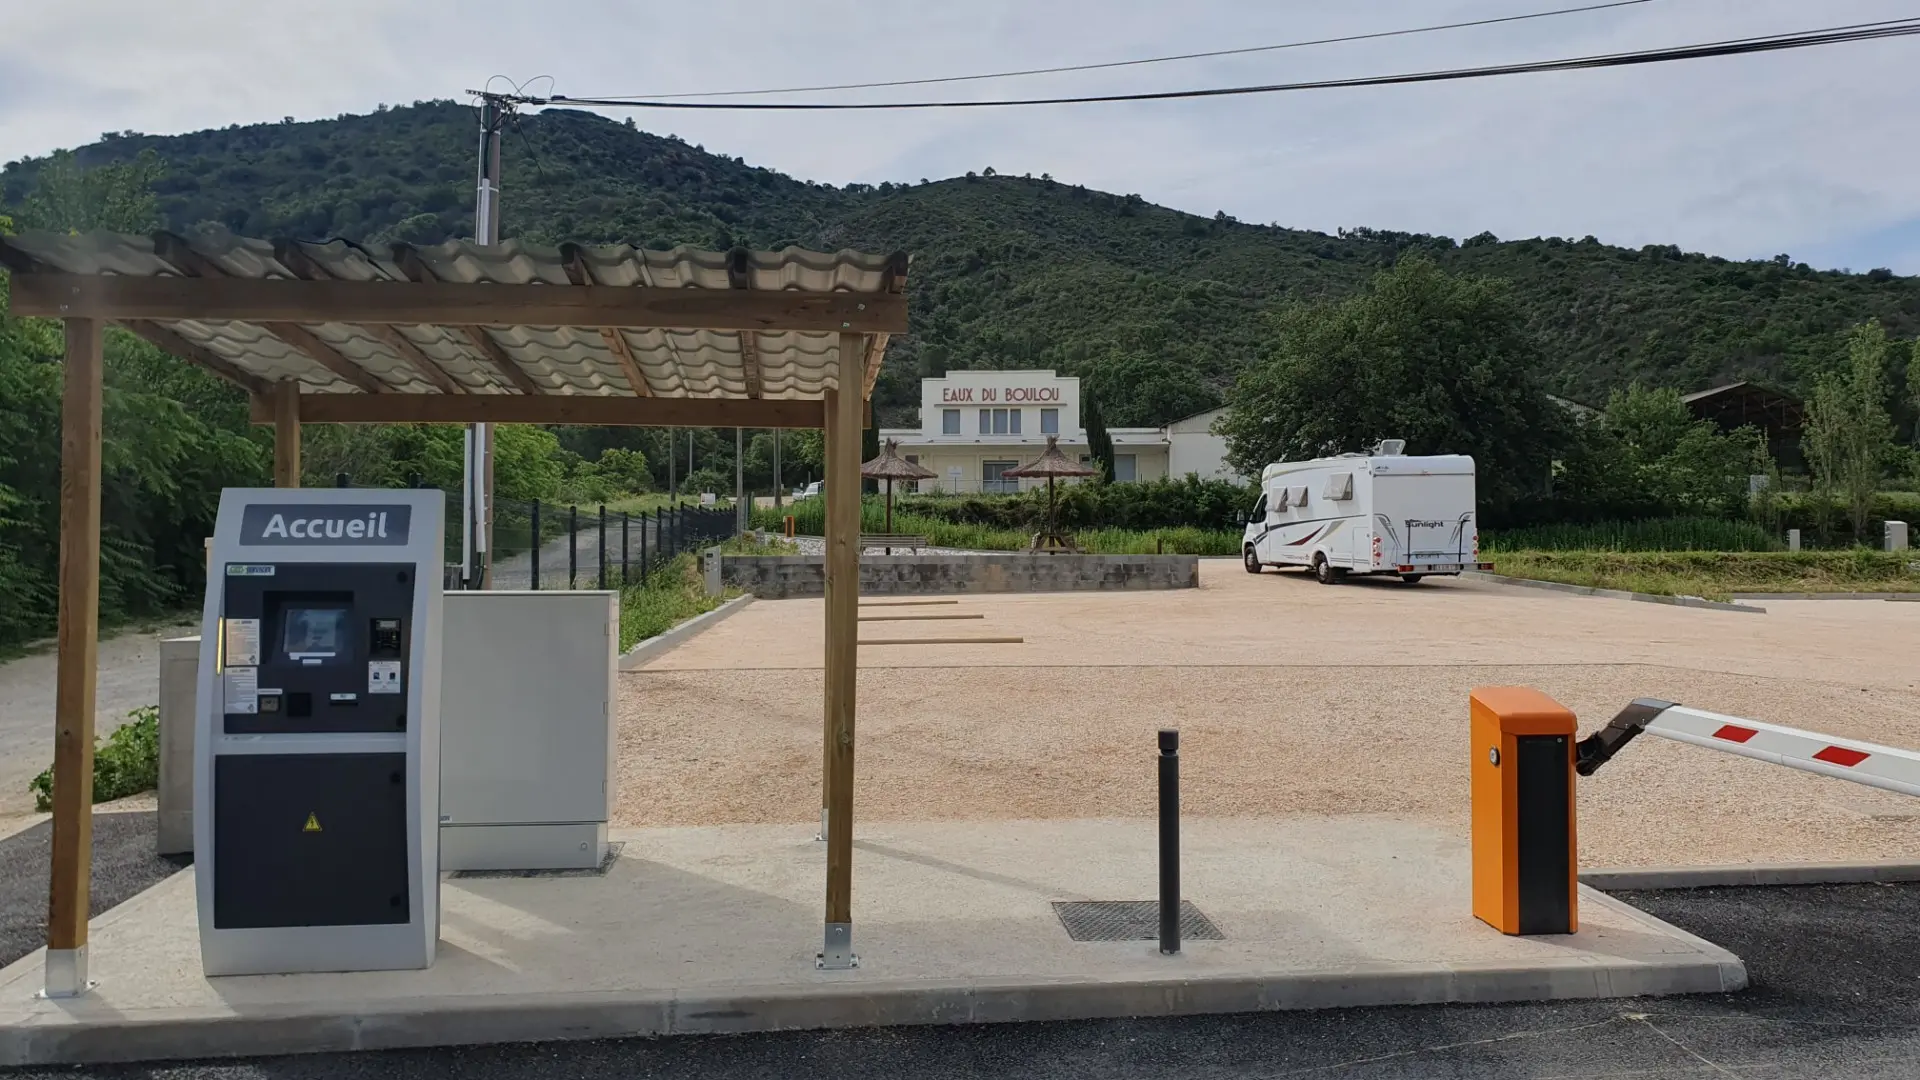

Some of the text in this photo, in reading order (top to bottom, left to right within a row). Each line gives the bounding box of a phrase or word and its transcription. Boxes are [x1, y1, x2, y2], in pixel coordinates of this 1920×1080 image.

[943, 388, 1059, 402] EAUX DU BOULOU
[262, 512, 388, 538] Accueil
[1405, 520, 1444, 529] Sunlight
